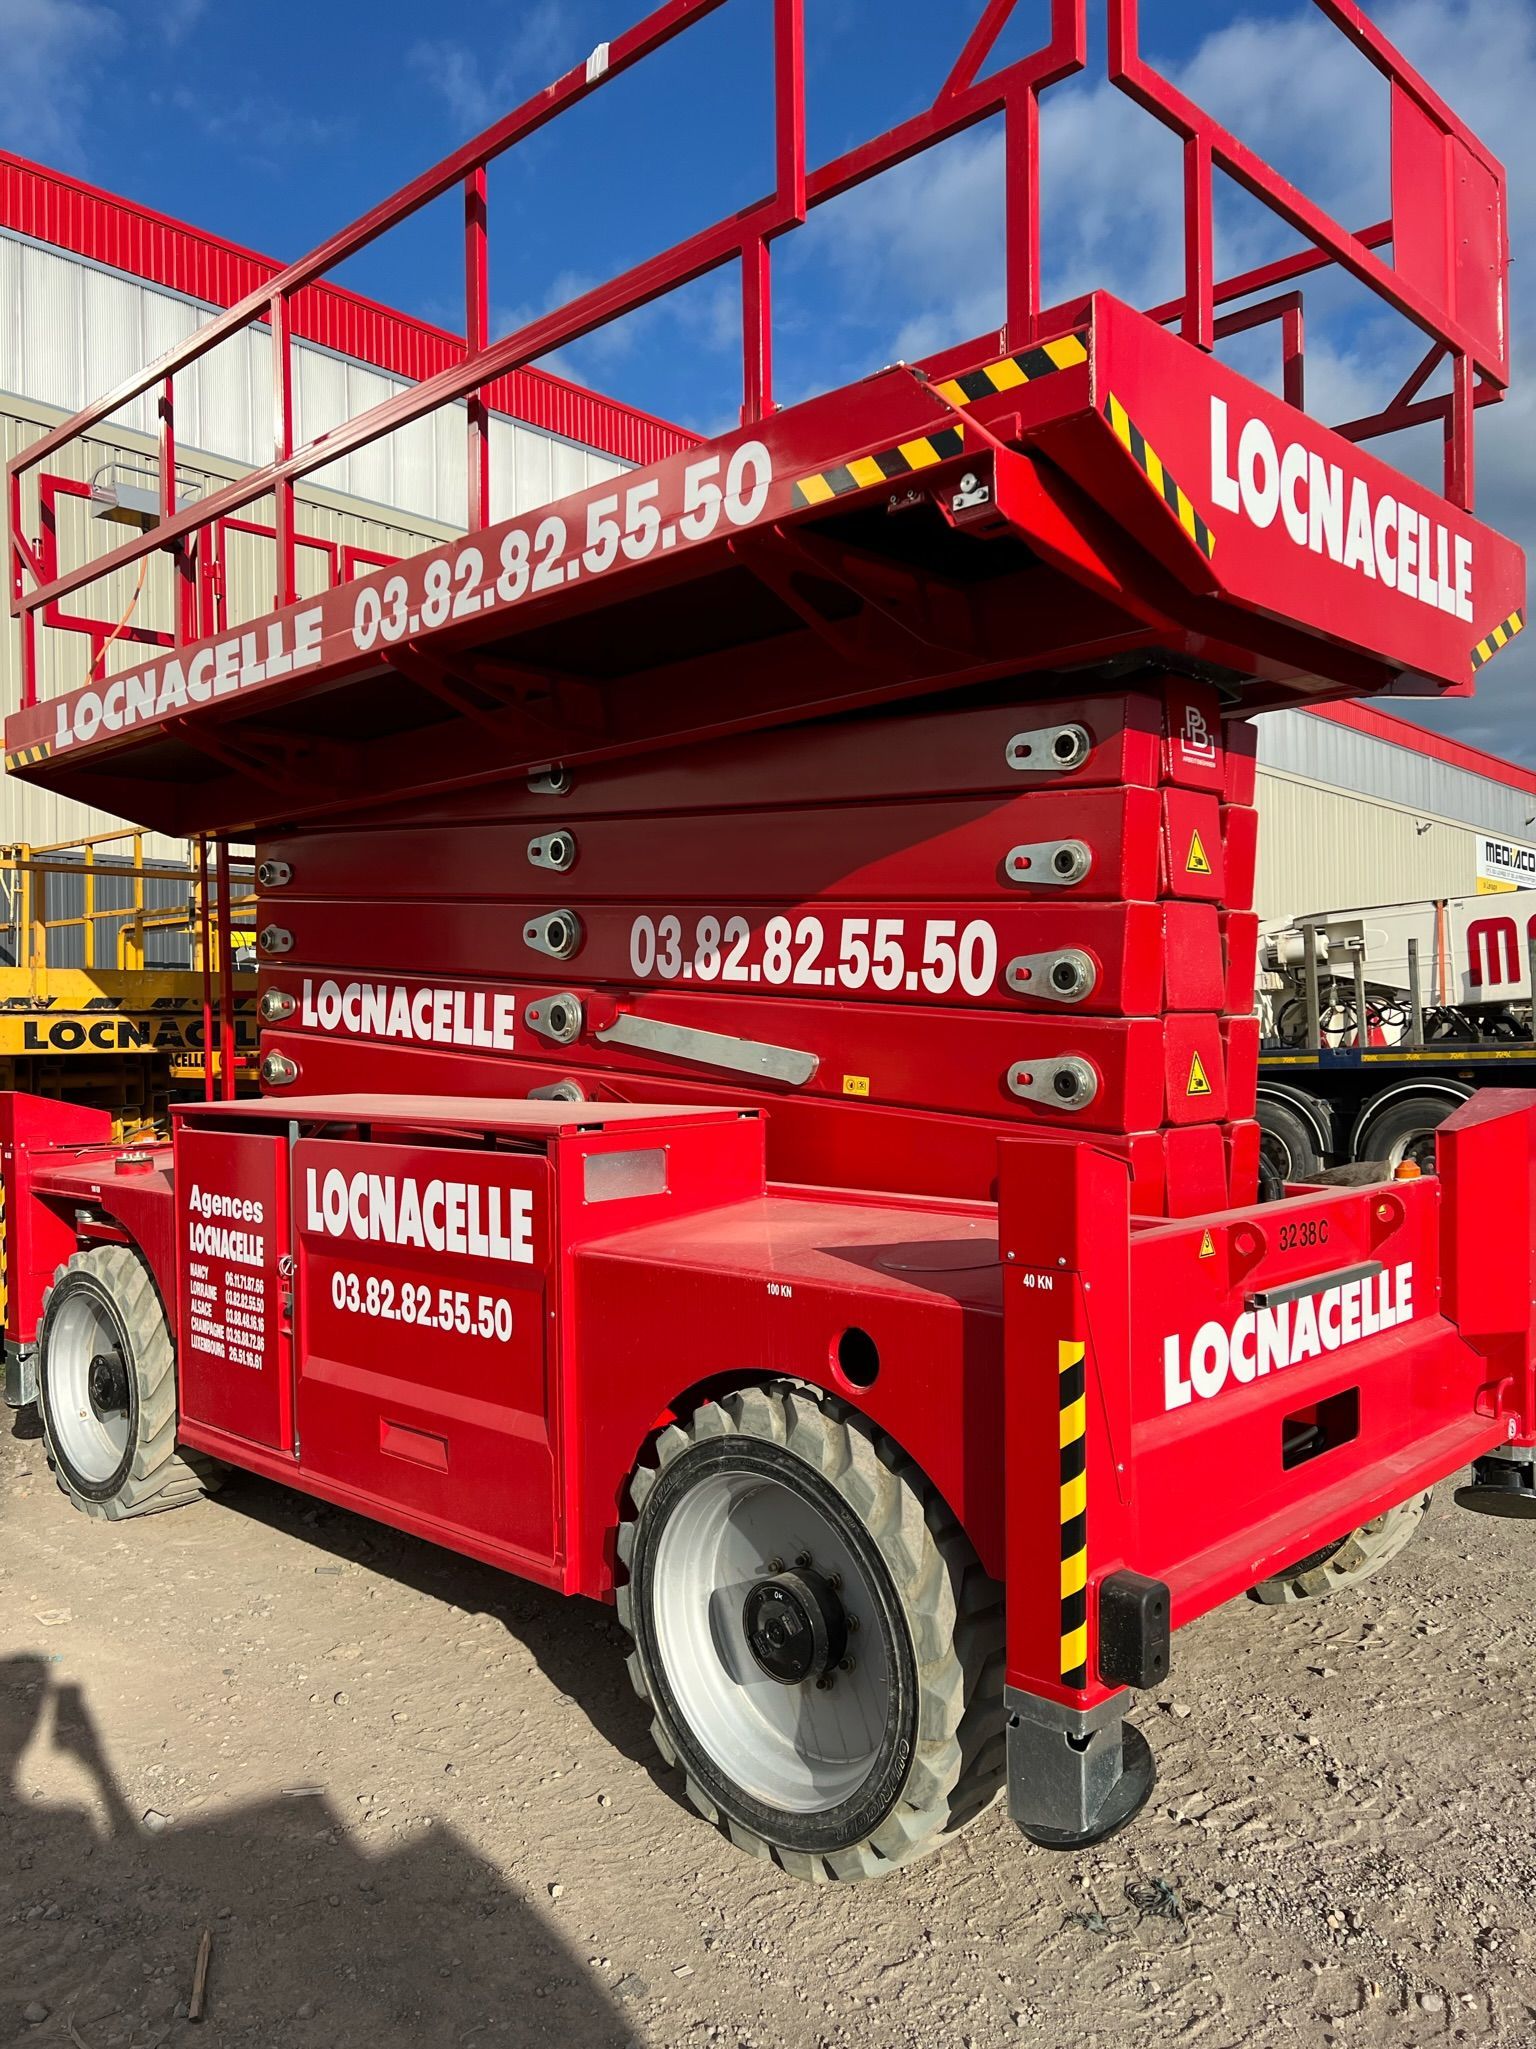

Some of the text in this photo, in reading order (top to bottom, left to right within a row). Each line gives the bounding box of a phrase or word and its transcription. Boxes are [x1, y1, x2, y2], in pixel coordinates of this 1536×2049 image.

[1210, 395, 1475, 624] LOCNACELLE
[54, 440, 773, 749] LOCNACELLE 03.82.82.55.50
[630, 914, 998, 997] 03.82.82.55.50
[302, 978, 515, 1050] LOCNACELLE
[189, 1184, 264, 1224] Agences
[306, 1167, 534, 1264] LOCNACELLE
[189, 1221, 264, 1268] LOCNACELLE
[190, 1262, 264, 1295] NANCY 06.11.71.87.66
[190, 1279, 264, 1314] LORRAINE 03.82.82.55.50
[766, 1282, 792, 1298] 100 KN
[1023, 1273, 1053, 1290] 40 KN
[190, 1298, 213, 1318] ALSACE
[190, 1315, 225, 1340] CHAMPAGNE
[331, 1271, 513, 1342] 03.82.82.55.50
[1164, 1261, 1413, 1411] LOCNACELLE
